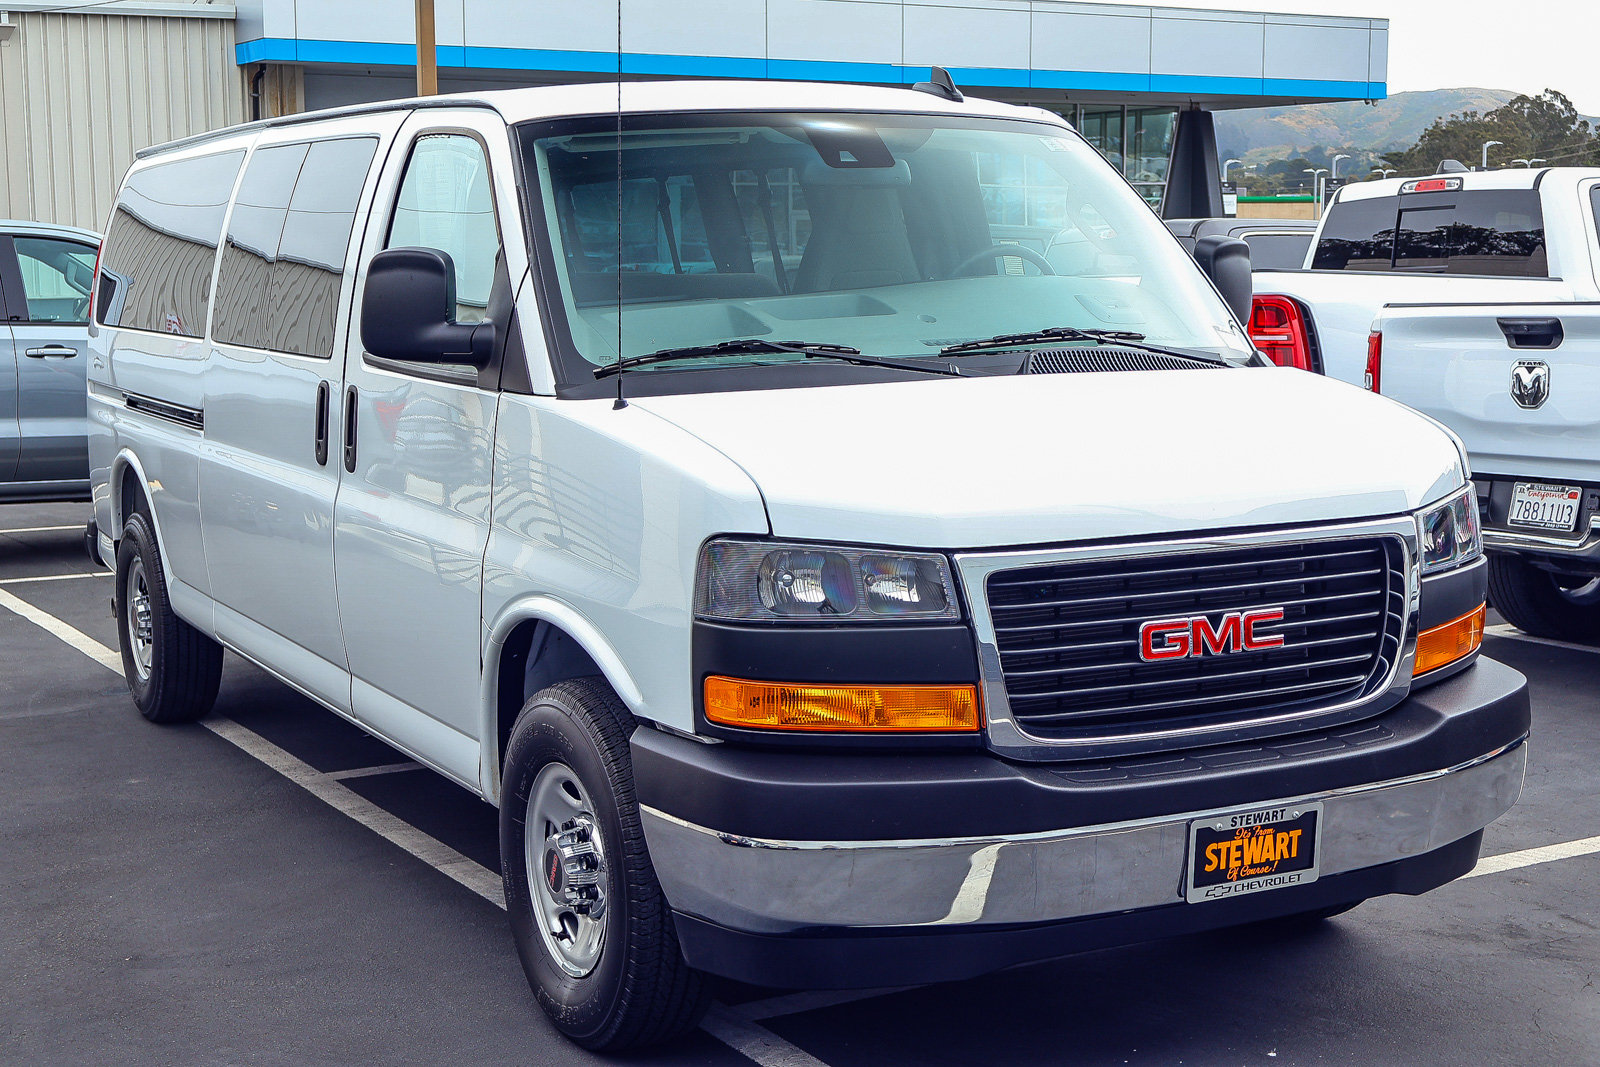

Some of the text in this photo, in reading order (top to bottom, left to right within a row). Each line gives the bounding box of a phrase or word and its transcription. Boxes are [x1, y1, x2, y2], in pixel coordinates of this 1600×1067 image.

[1528, 491, 1568, 500] California
[1516, 500, 1573, 523] 78811U3
[1139, 607, 1284, 662] GMC
[1230, 809, 1286, 827] STEWART
[1251, 825, 1275, 838] From
[1204, 829, 1302, 872] STEWART
[1227, 866, 1239, 882] Of
[1234, 873, 1302, 892] CHEVROLET
